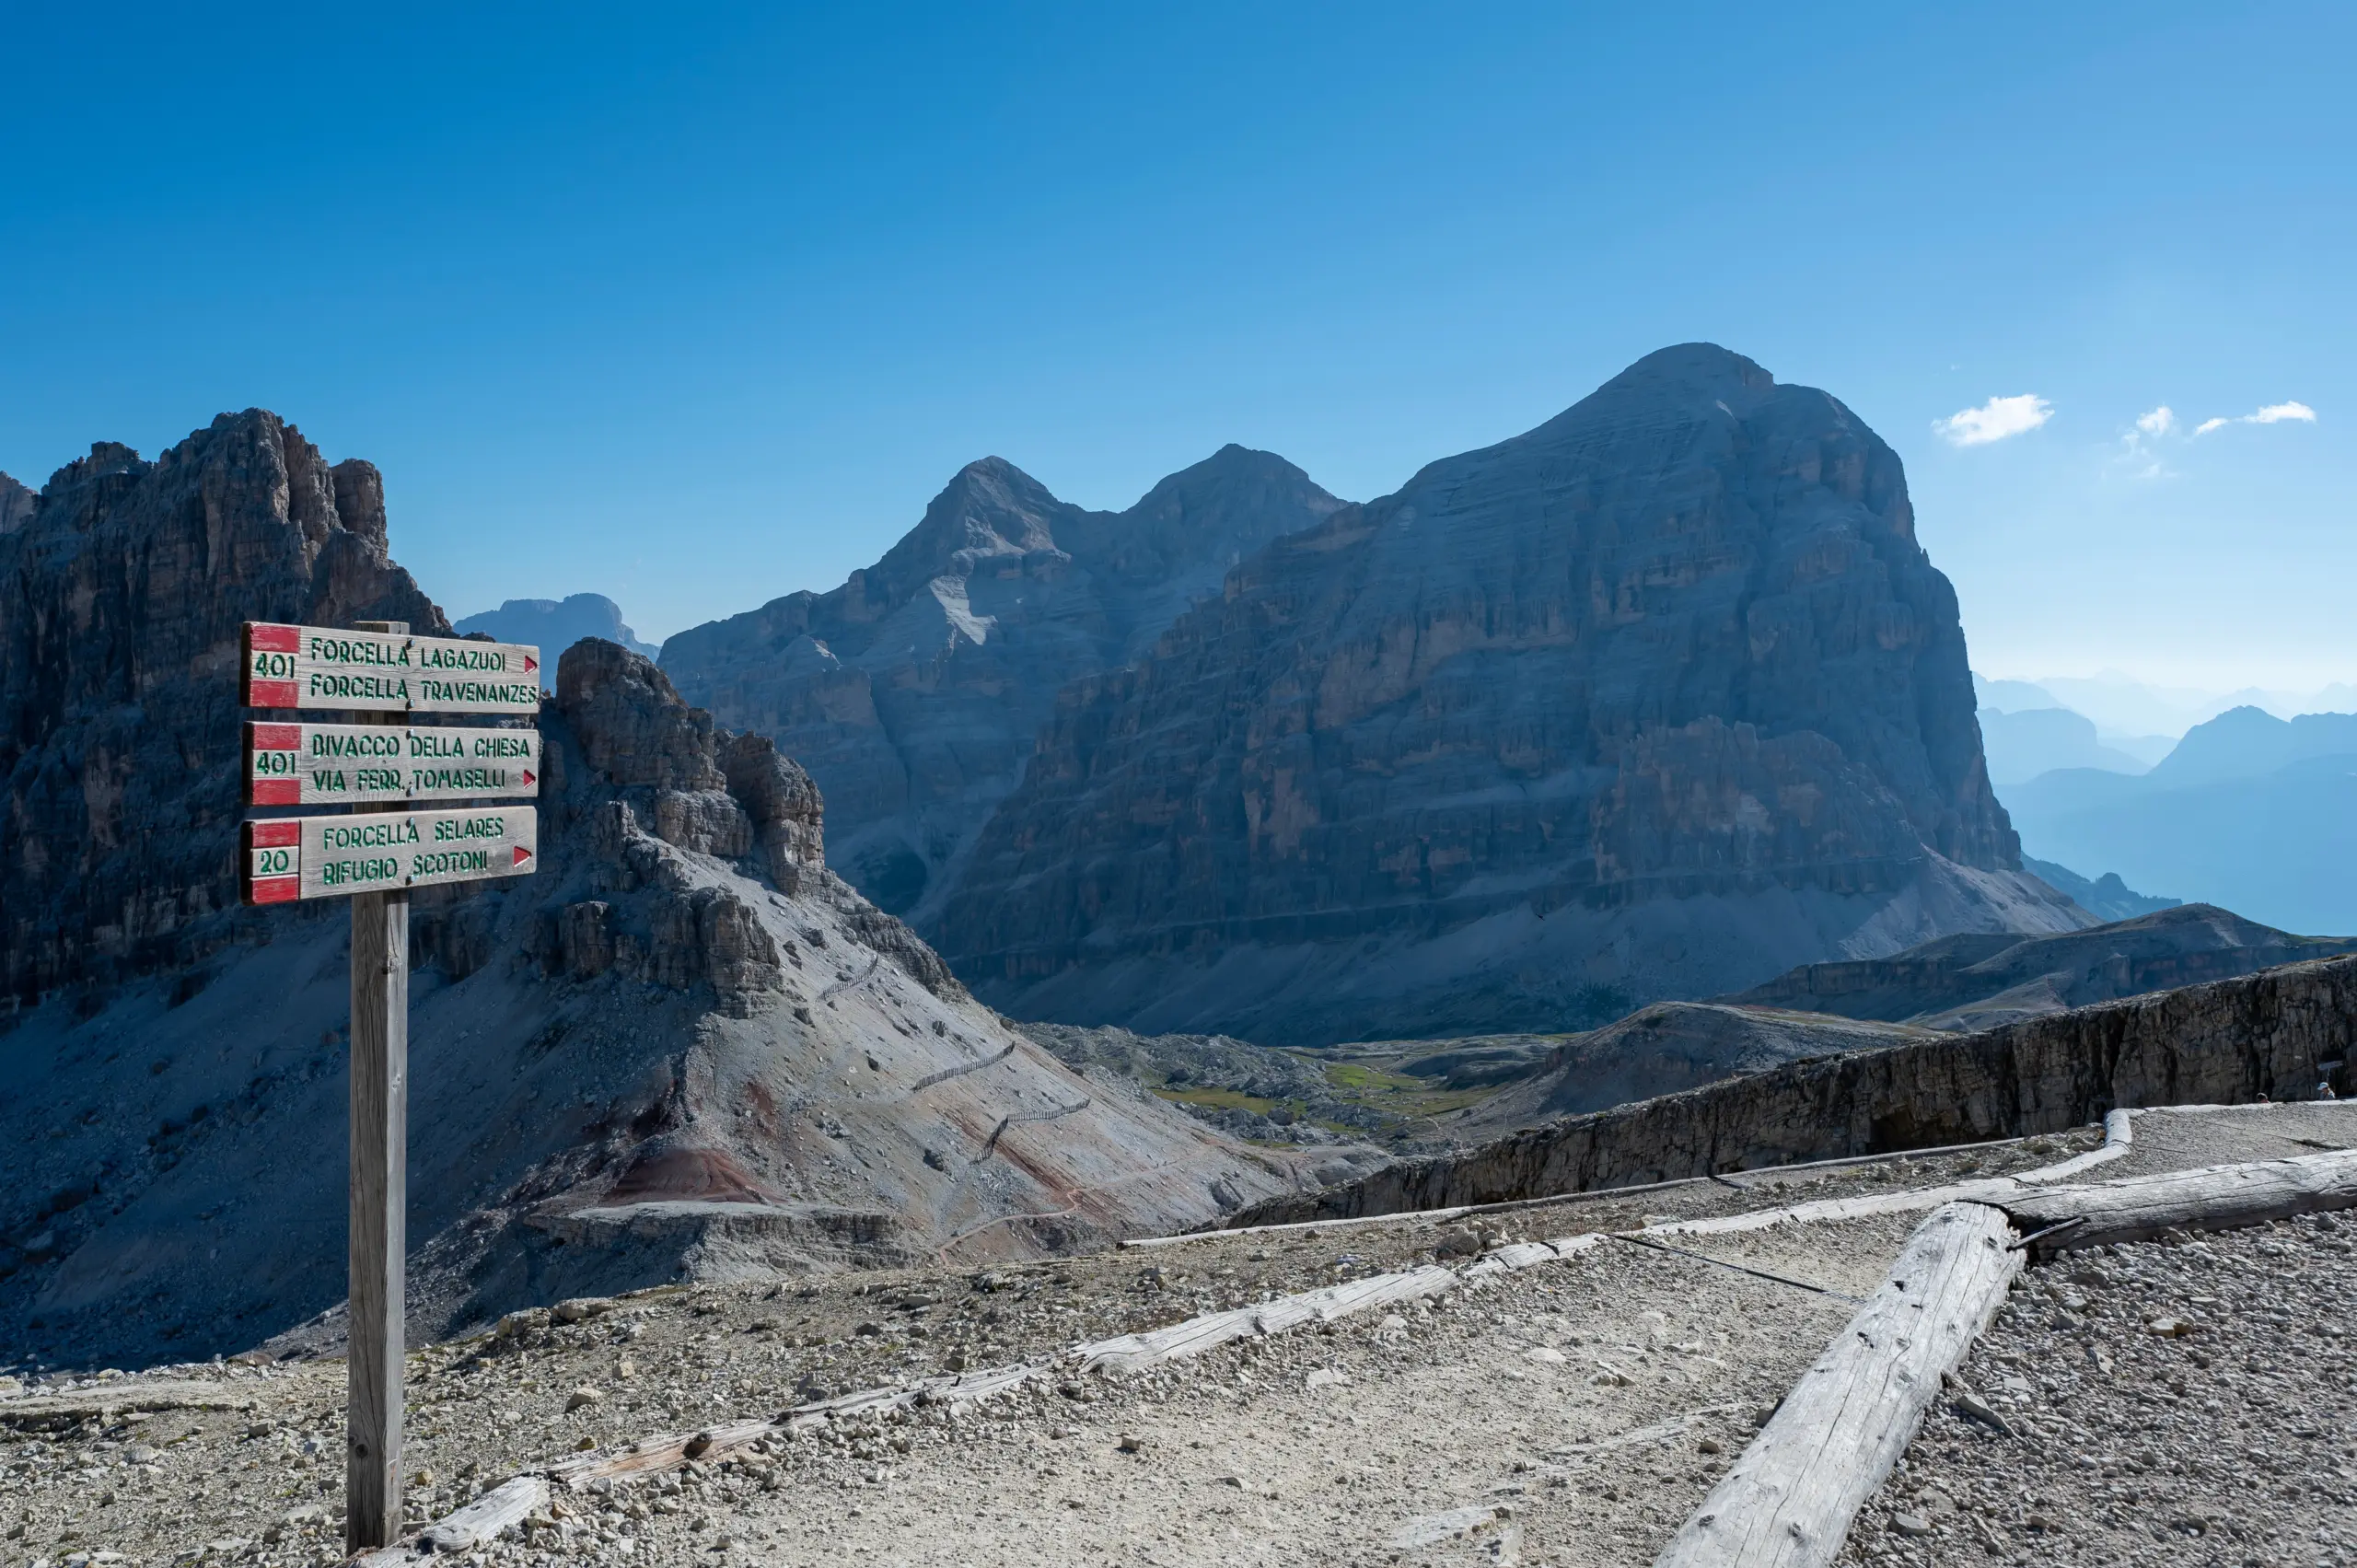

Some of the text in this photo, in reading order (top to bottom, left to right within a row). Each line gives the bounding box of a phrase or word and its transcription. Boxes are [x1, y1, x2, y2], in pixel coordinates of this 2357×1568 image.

[255, 653, 296, 679] 401
[310, 637, 505, 672] FORCELLA LAGAZUOI
[310, 673, 537, 704] FORCELLA TRAVENANZES
[411, 737, 465, 759] DELLA
[256, 751, 296, 776] 401
[312, 770, 347, 792] VIA
[413, 768, 505, 791] TOMASELLI
[323, 817, 505, 852] FORCELLA SELARES
[261, 850, 289, 874] 20
[323, 850, 488, 887] RIFUGIO SCOTONI
